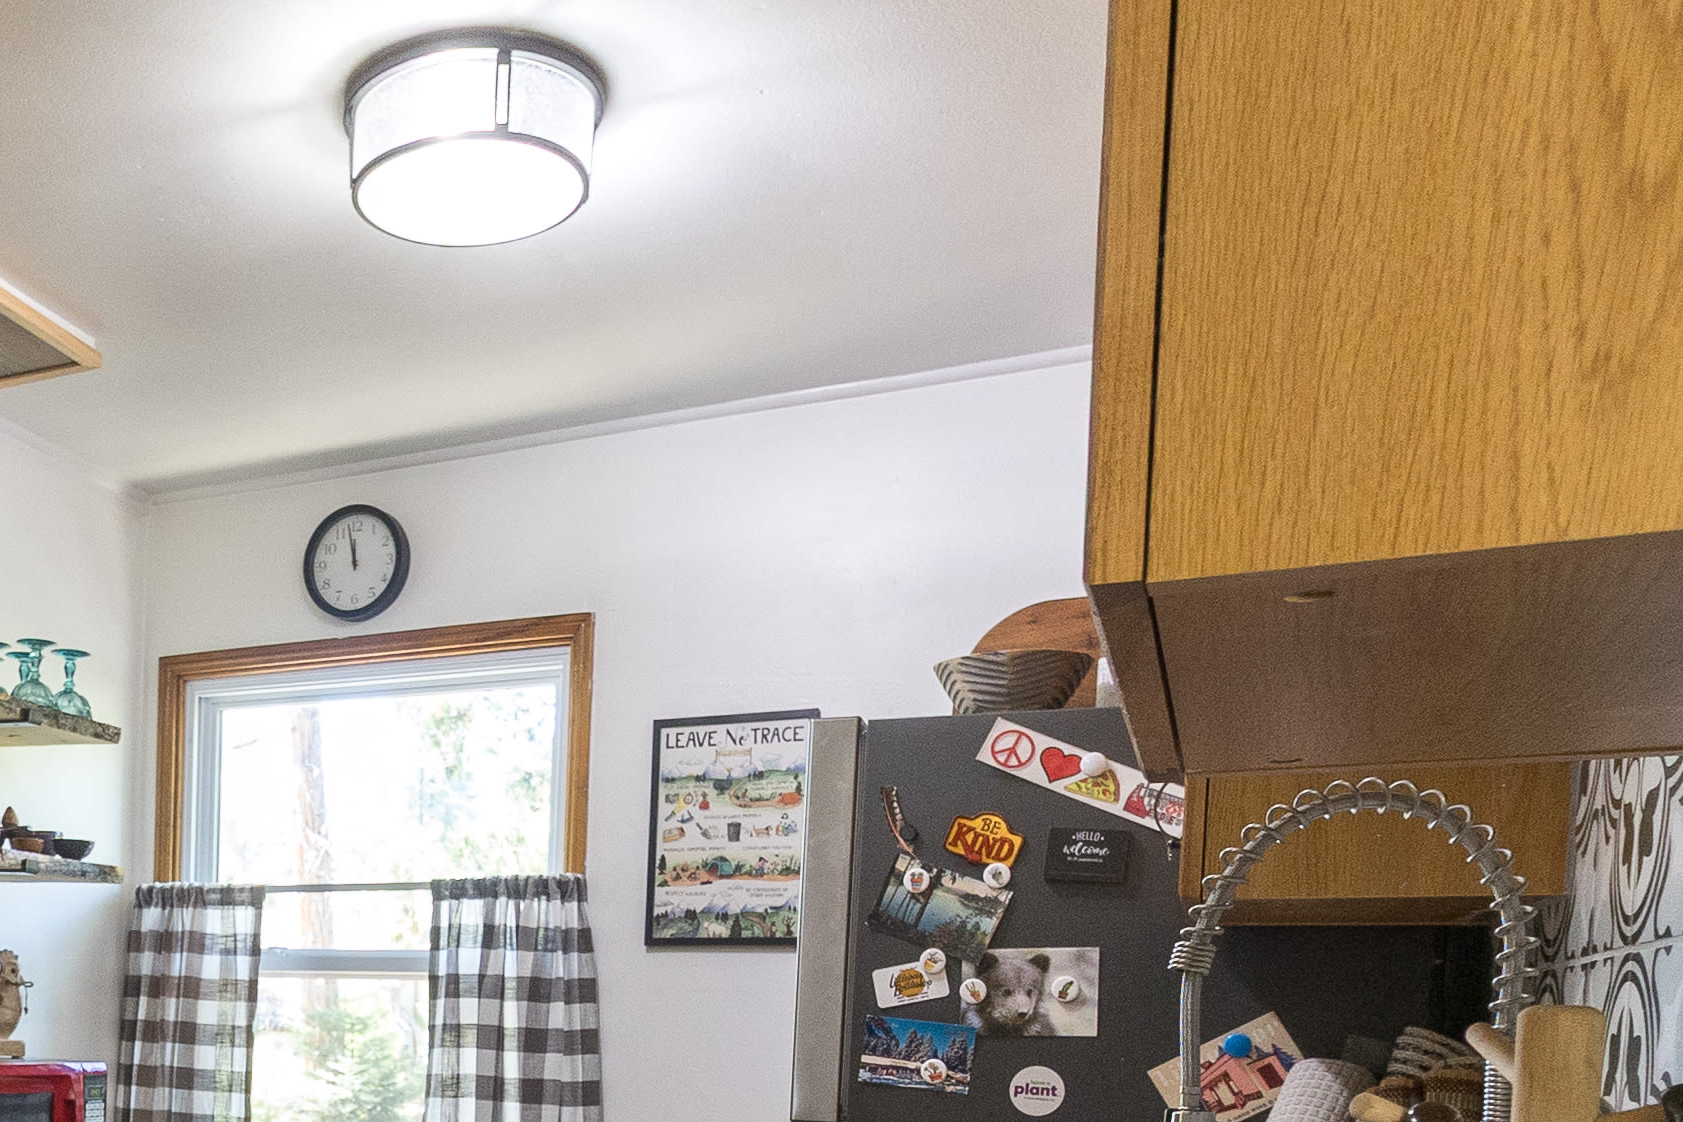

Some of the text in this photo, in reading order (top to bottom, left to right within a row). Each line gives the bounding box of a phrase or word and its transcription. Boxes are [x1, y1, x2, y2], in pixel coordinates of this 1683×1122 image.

[352, 520, 363, 532] 12
[381, 535, 390, 547] 2
[324, 542, 337, 556] 10
[666, 731, 717, 749] LEAVE
[751, 726, 804, 745] TRACE
[980, 817, 1001, 835] BE
[948, 822, 1015, 863] KIND
[1076, 831, 1101, 842] HELLO
[1063, 842, 1110, 856] welcome
[1014, 1082, 1058, 1098] plant
